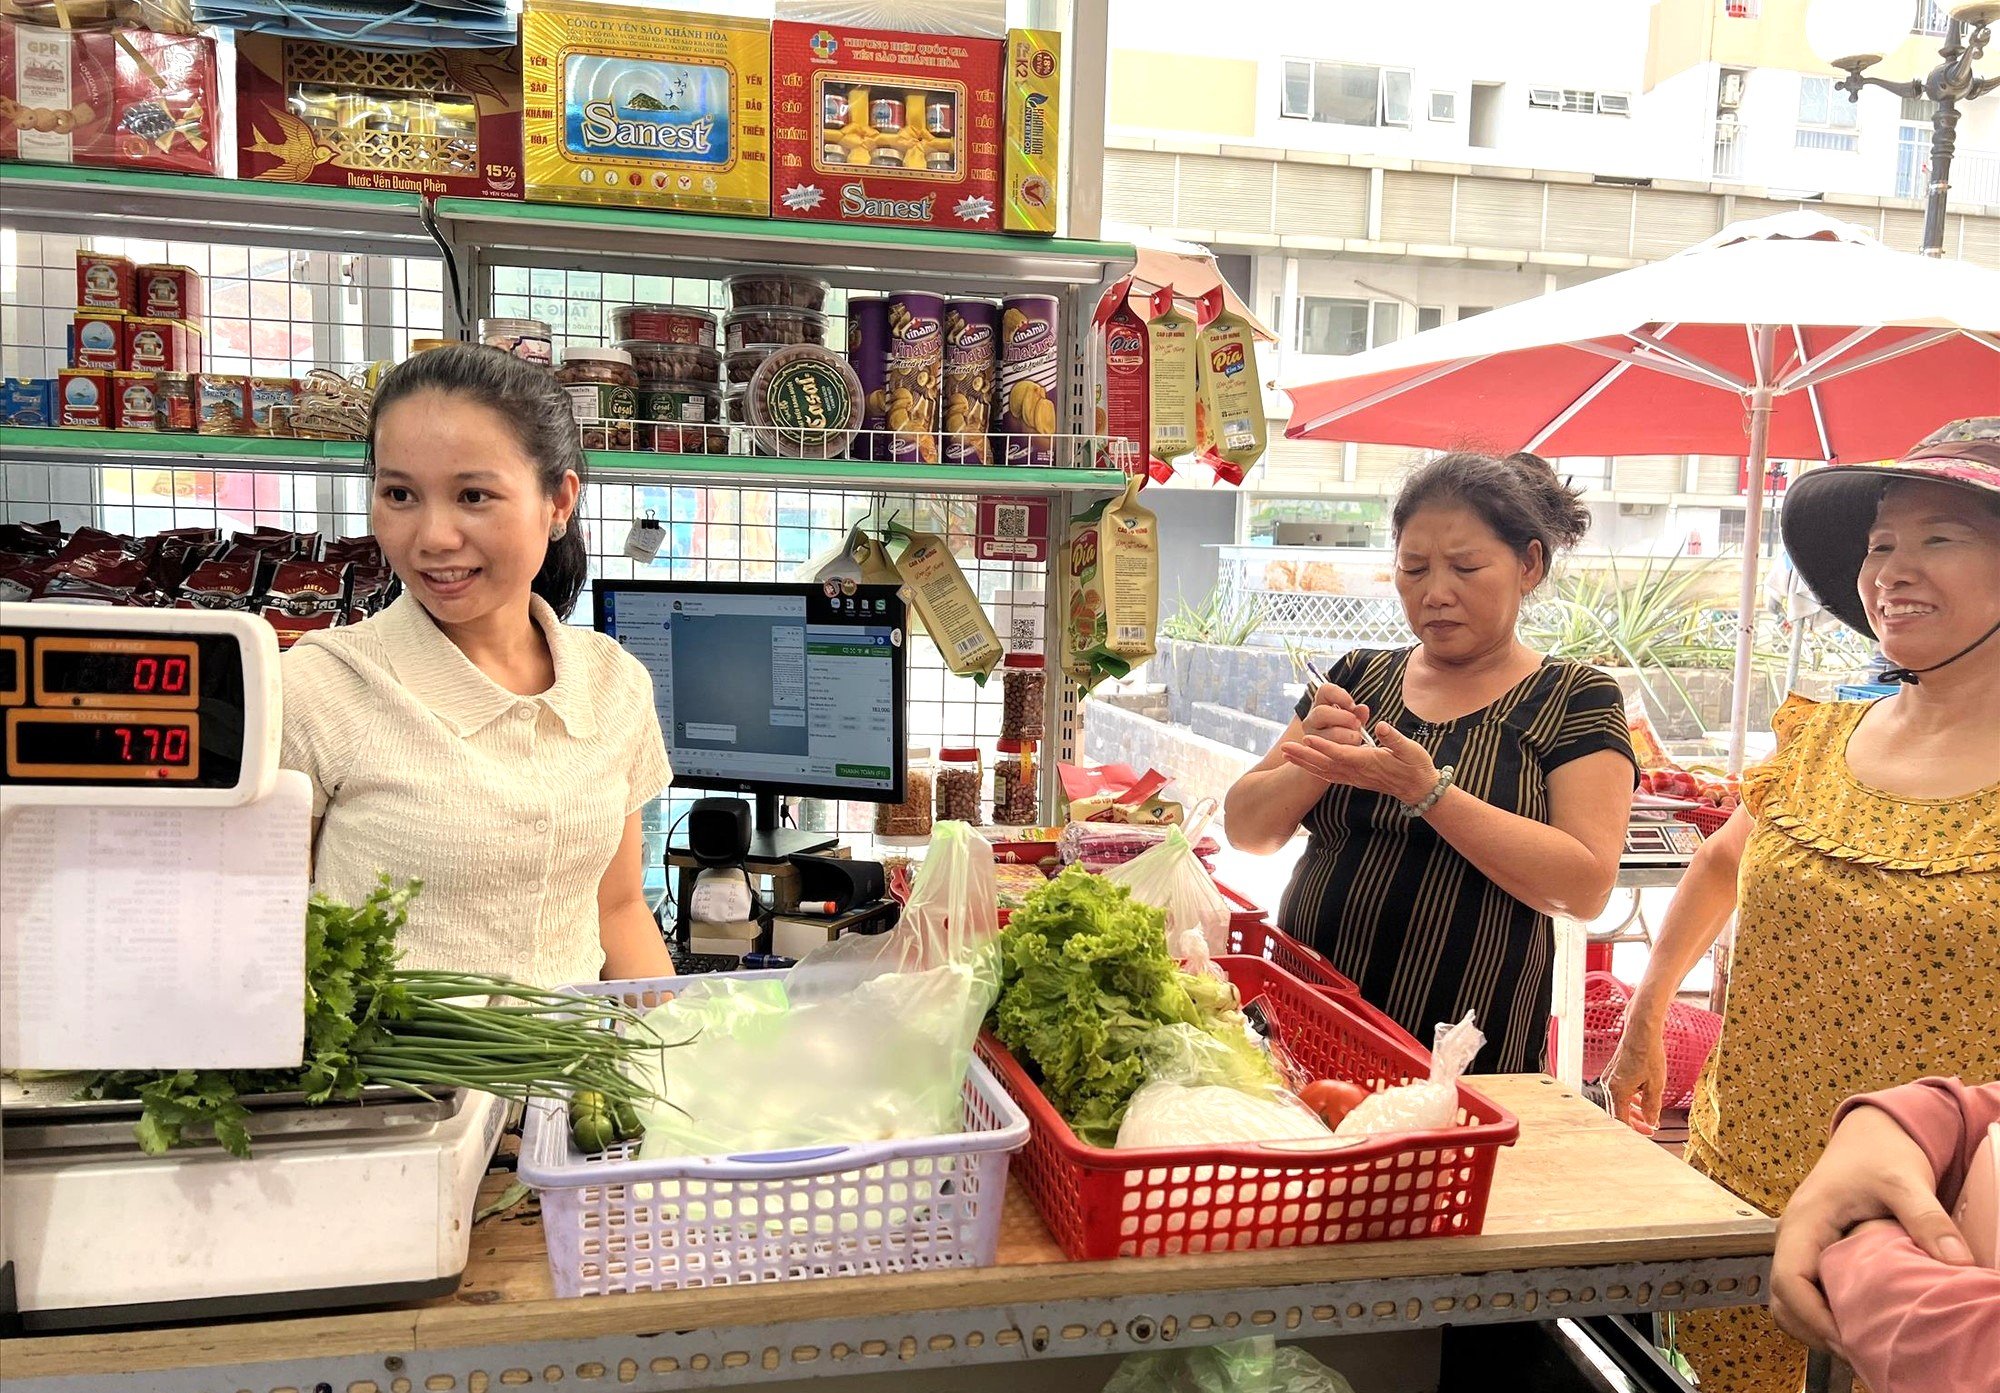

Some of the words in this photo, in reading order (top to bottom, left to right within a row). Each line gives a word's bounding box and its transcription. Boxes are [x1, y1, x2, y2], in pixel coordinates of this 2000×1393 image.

[566, 18, 598, 30] CÔNG
[601, 21, 615, 31] TY
[617, 21, 638, 33] YẾN
[640, 24, 662, 36] SÀO
[664, 26, 702, 39] KHÁNH
[705, 31, 728, 42] HÒA
[28, 41, 59, 55] GPR
[843, 36, 889, 50] THƯƠNG
[890, 40, 916, 53] HIỆU
[917, 42, 948, 56] QUỐC
[949, 47, 968, 57] GIA
[530, 56, 548, 67] YẾN
[852, 49, 875, 61] YẾN
[875, 51, 898, 63] SÀO
[898, 53, 938, 67] KHÁNH
[937, 57, 960, 68] HÒA
[1016, 60, 1028, 78] K2
[530, 81, 548, 93] SÀO
[745, 73, 763, 86] YẾN
[782, 73, 803, 87] YẾN
[975, 89, 995, 102] YẾN
[745, 98, 763, 111] ĐẢO
[781, 100, 802, 113] SÀO
[525, 107, 553, 120] KHÁNH
[584, 99, 711, 153] Sanest
[975, 116, 995, 128] ĐẢO
[742, 124, 766, 137] THIÊN
[776, 126, 809, 141] KHÁNH
[1024, 108, 1032, 155] NUTRITION
[530, 134, 548, 146] HÒA
[741, 149, 766, 162] NHIÊN
[972, 142, 998, 155] THIÊN
[781, 153, 803, 168] HÒA
[486, 164, 517, 179] 15%
[971, 167, 998, 181] NHIÊN
[347, 172, 372, 187] Nước
[373, 173, 391, 188] Yến
[392, 175, 422, 191] Đường
[423, 178, 447, 193] Phèn
[841, 180, 932, 221] Sanest
[84, 293, 120, 308] Sanest
[146, 306, 179, 318] Sanest
[905, 322, 937, 340] vinamit
[960, 328, 991, 346] vinamit
[1014, 324, 1045, 343] vinamit
[1110, 336, 1140, 355] Pía
[79, 355, 117, 370] Sanest
[1213, 350, 1242, 371] Pía
[612, 403, 634, 415] Cosal
[794, 376, 826, 428] Cosal
[63, 413, 100, 426] Sanest
[1073, 543, 1096, 573] Pía
[270, 598, 308, 610] SANG
[313, 599, 338, 609] TAO
[115, 728, 187, 761] 7.70
